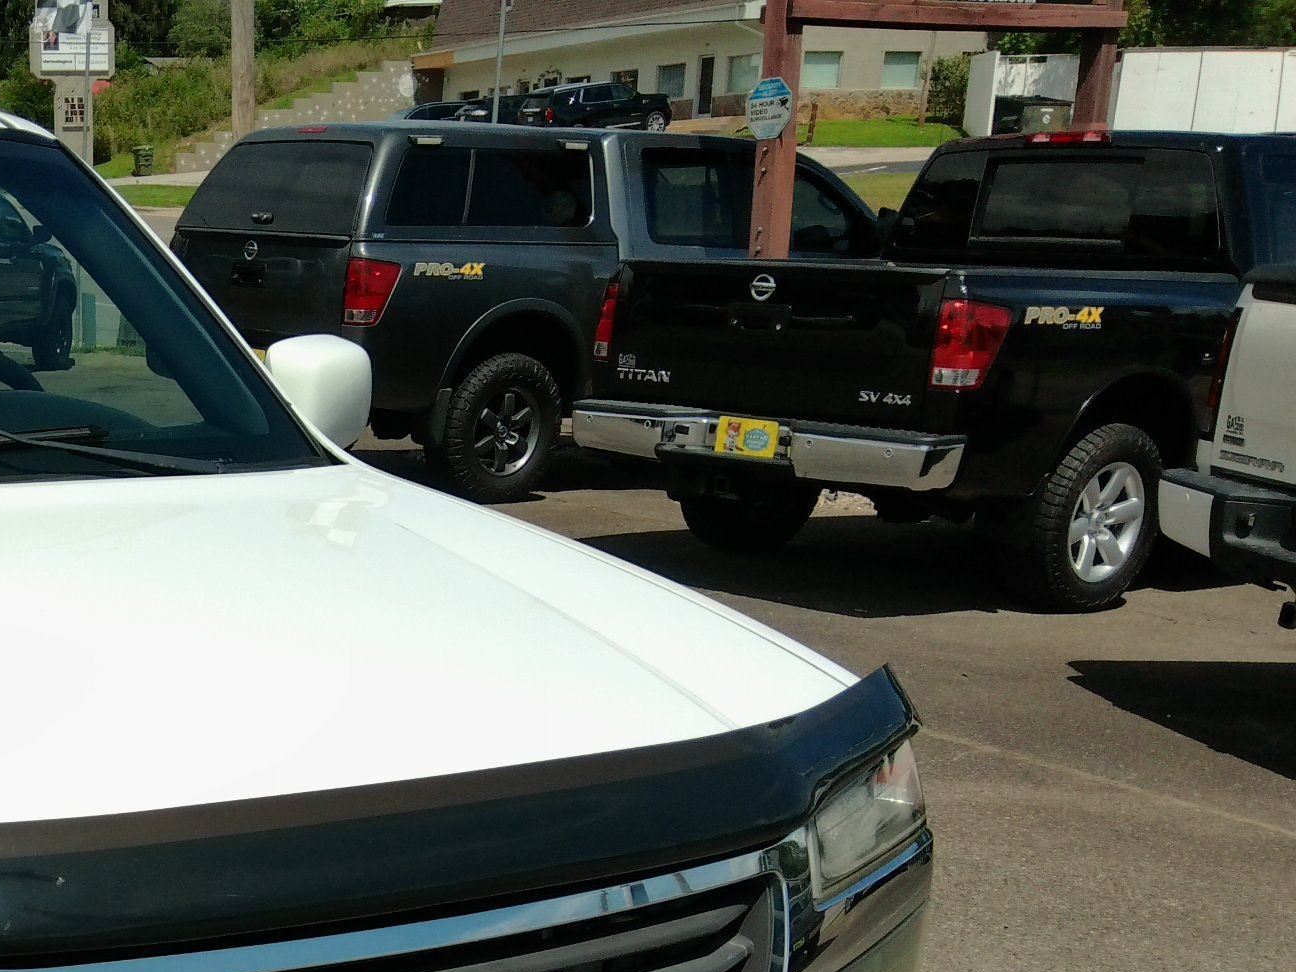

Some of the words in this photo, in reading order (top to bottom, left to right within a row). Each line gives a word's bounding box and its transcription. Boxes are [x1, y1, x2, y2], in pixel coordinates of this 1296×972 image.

[759, 100, 775, 108] HOUR
[413, 262, 486, 276] PRO-4X
[1023, 306, 1105, 325] PRO-4X
[616, 367, 671, 383] TITAN
[858, 390, 881, 403] SV
